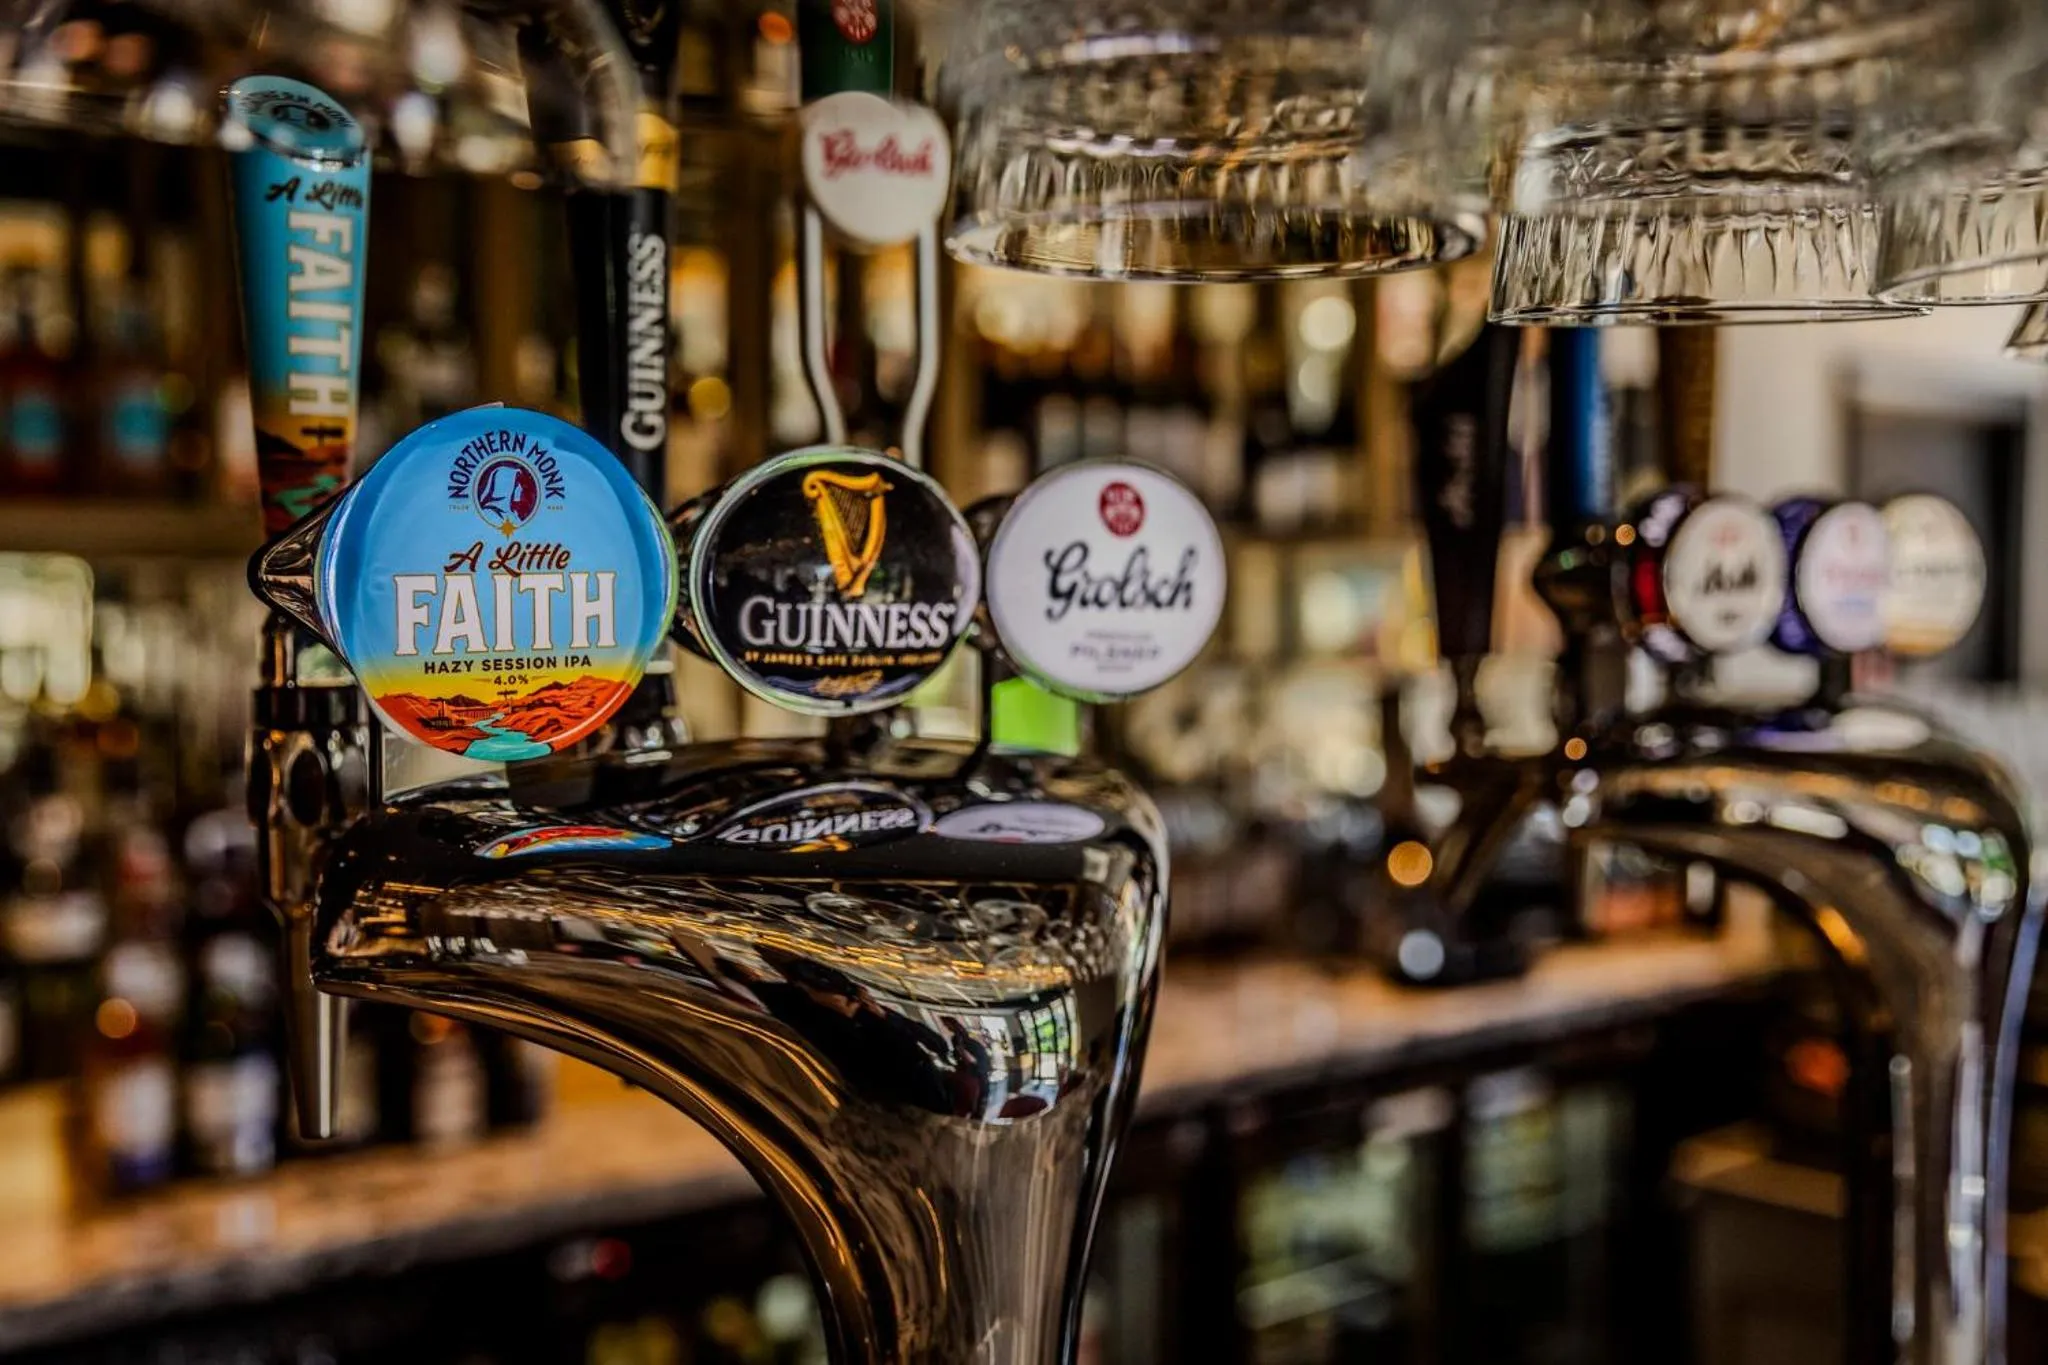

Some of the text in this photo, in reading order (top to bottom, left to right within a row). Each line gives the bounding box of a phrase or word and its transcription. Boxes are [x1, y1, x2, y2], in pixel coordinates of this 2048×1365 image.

[264, 176, 300, 203] A
[287, 211, 352, 415] FAITH
[620, 233, 666, 450] GUINNESS
[447, 429, 566, 500] NORTHERN MONK
[443, 541, 571, 578] A Little
[1044, 541, 1198, 622] Grolsch
[393, 571, 618, 657] FAITH
[739, 596, 955, 648] GUINNESS
[424, 655, 592, 674] HAZY SESSION IPA
[493, 674, 530, 686] 4.0%
